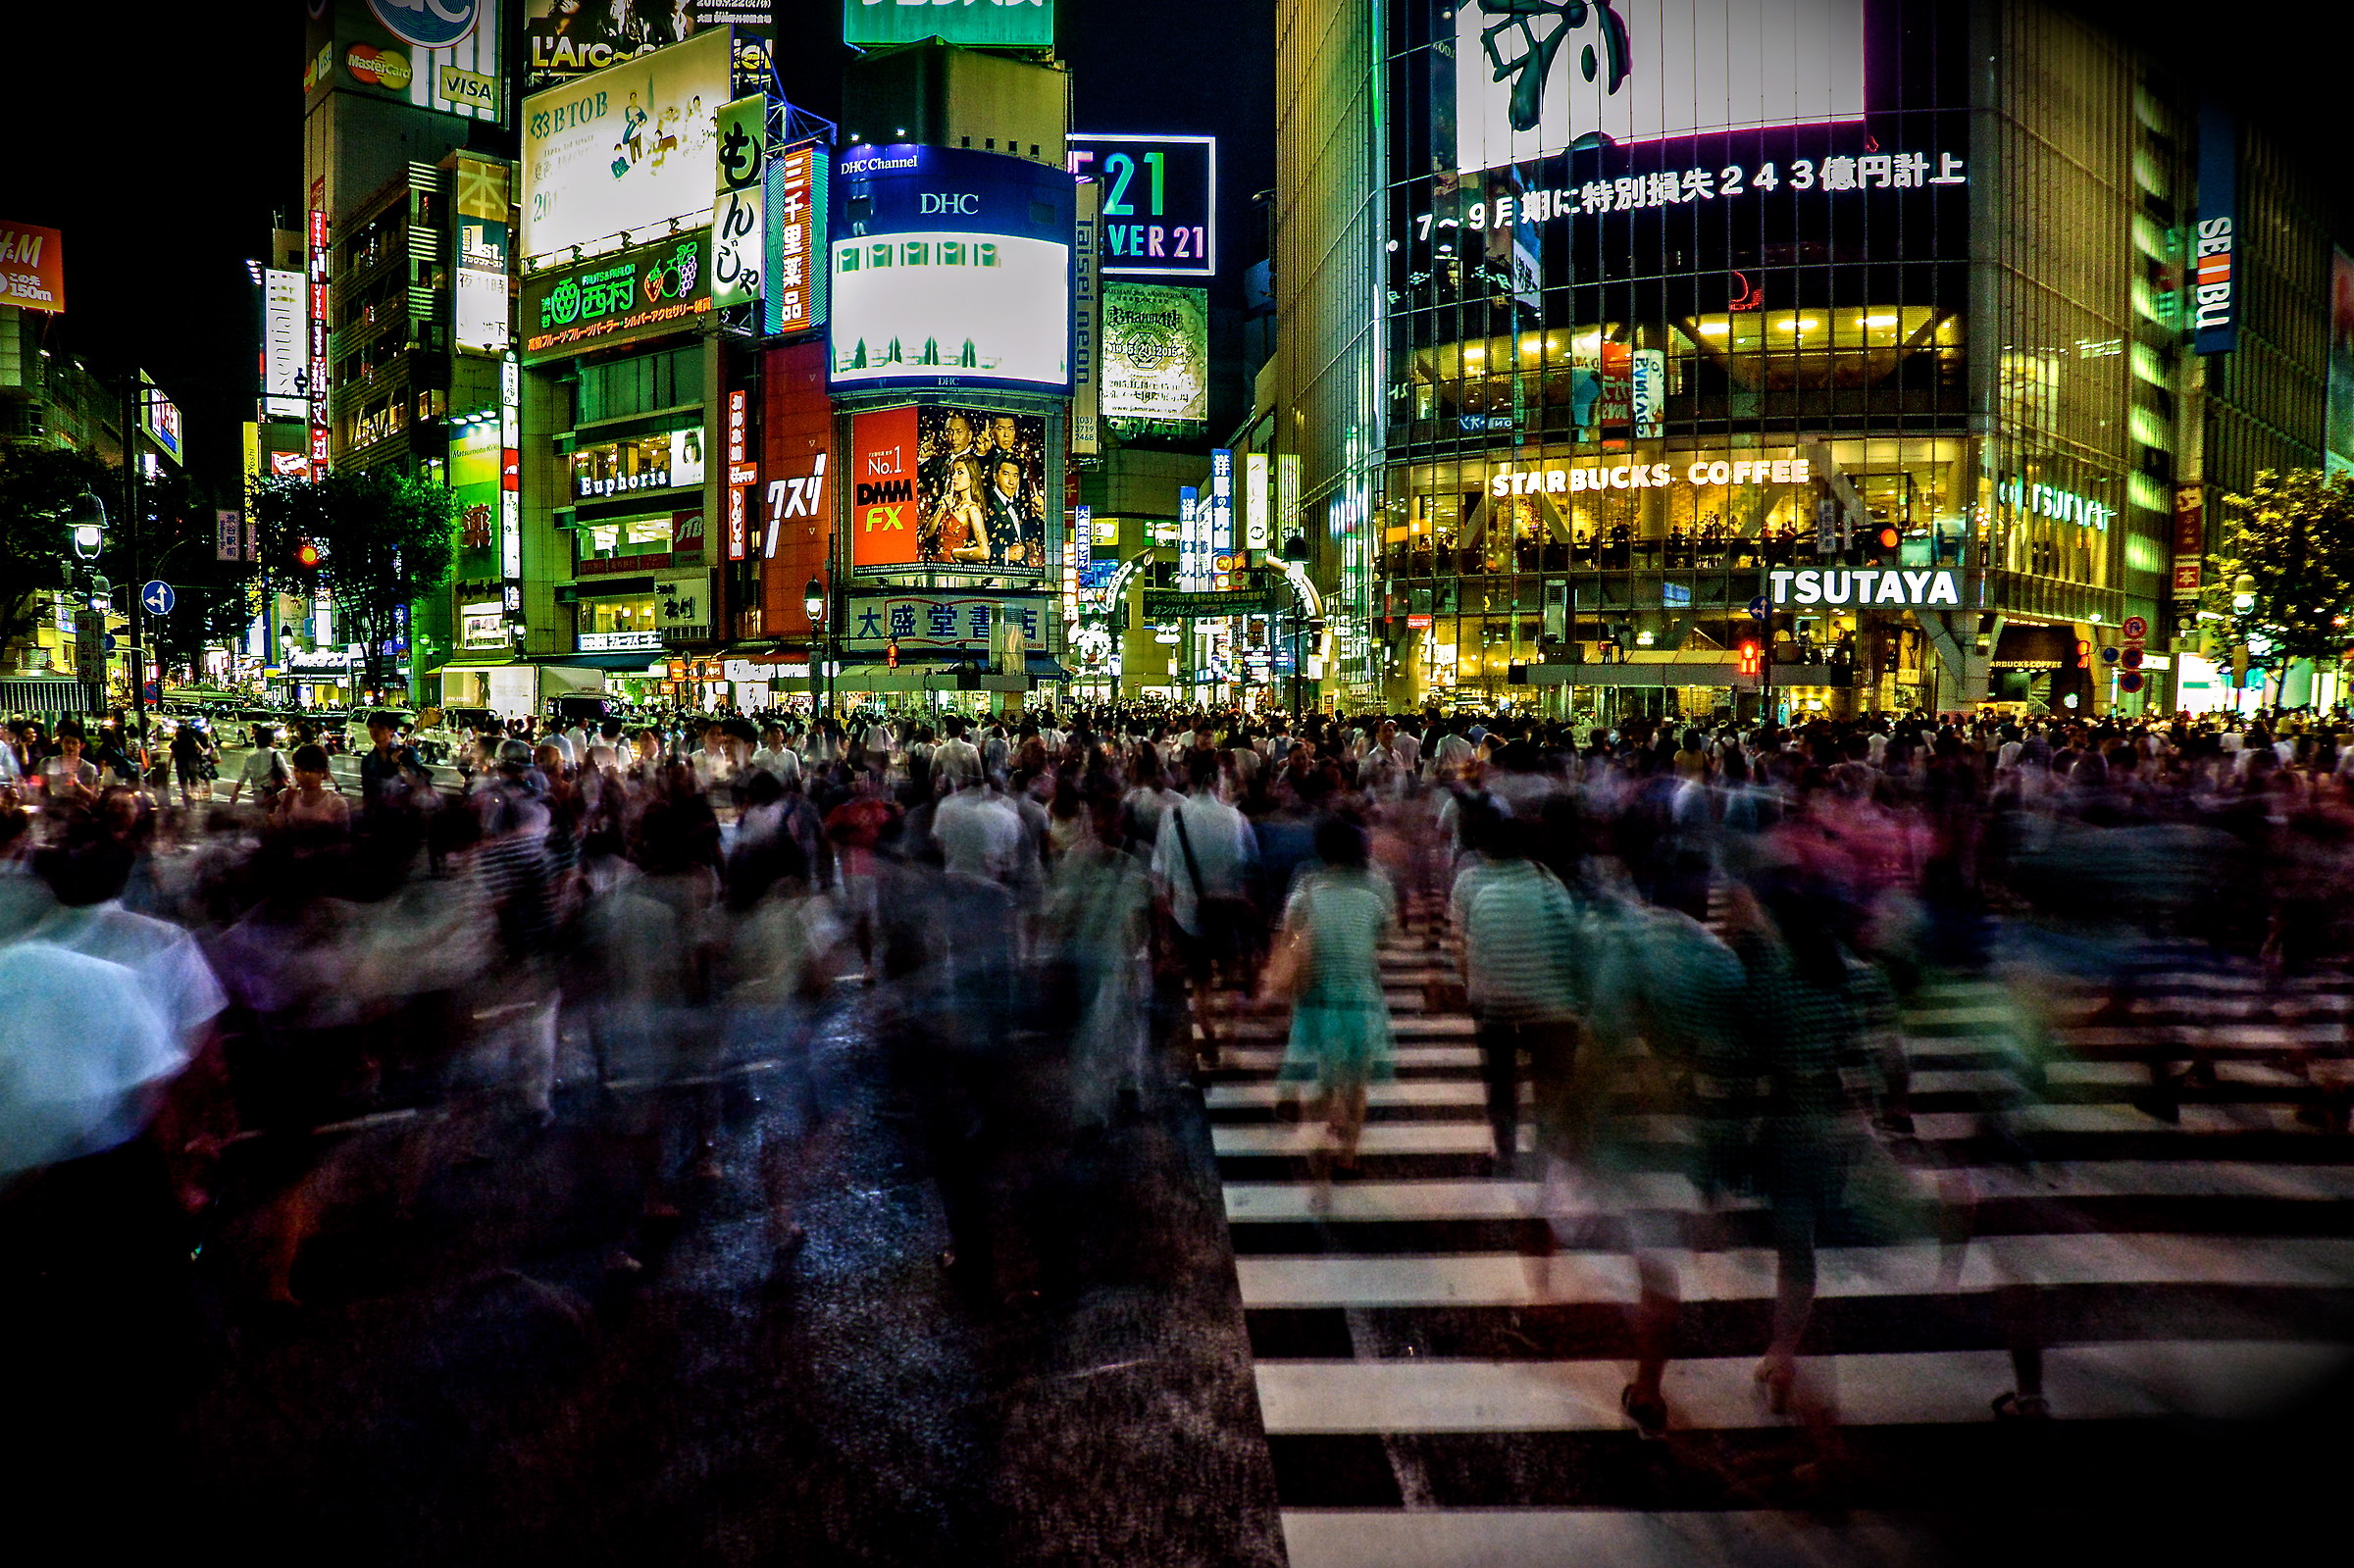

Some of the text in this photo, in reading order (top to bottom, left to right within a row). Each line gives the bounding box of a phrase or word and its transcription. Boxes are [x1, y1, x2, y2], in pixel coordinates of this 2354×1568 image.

[348, 55, 411, 79] MasterCard
[446, 77, 491, 100] VISA
[553, 91, 608, 133] BTOB
[841, 156, 918, 175] DHC Channel
[458, 163, 508, 220] 本
[1102, 152, 1164, 216] 21
[717, 121, 762, 297] もんじゃ
[920, 193, 979, 215] DHC
[782, 157, 804, 322] 三千里薬品
[1107, 225, 1203, 259] VER 21
[2196, 217, 2232, 329] SEIBU
[9, 282, 53, 302] 150m
[581, 277, 636, 320] 西村
[1076, 213, 1095, 384] Taisei neon
[540, 297, 551, 329] 渋谷
[1155, 345, 1178, 357] 2015
[938, 377, 960, 386] DHC
[1076, 416, 1094, 425] (03)
[452, 446, 486, 459] Matsumoto
[868, 445, 902, 477] No.1
[580, 468, 667, 498] Euphoria
[856, 479, 913, 507] DMM
[1492, 459, 1811, 497] STARBUCKS COFFEE
[765, 453, 828, 559] クスリ
[865, 505, 904, 532] FX
[675, 516, 703, 543] JTB
[1768, 570, 1960, 605] TSUTAYA
